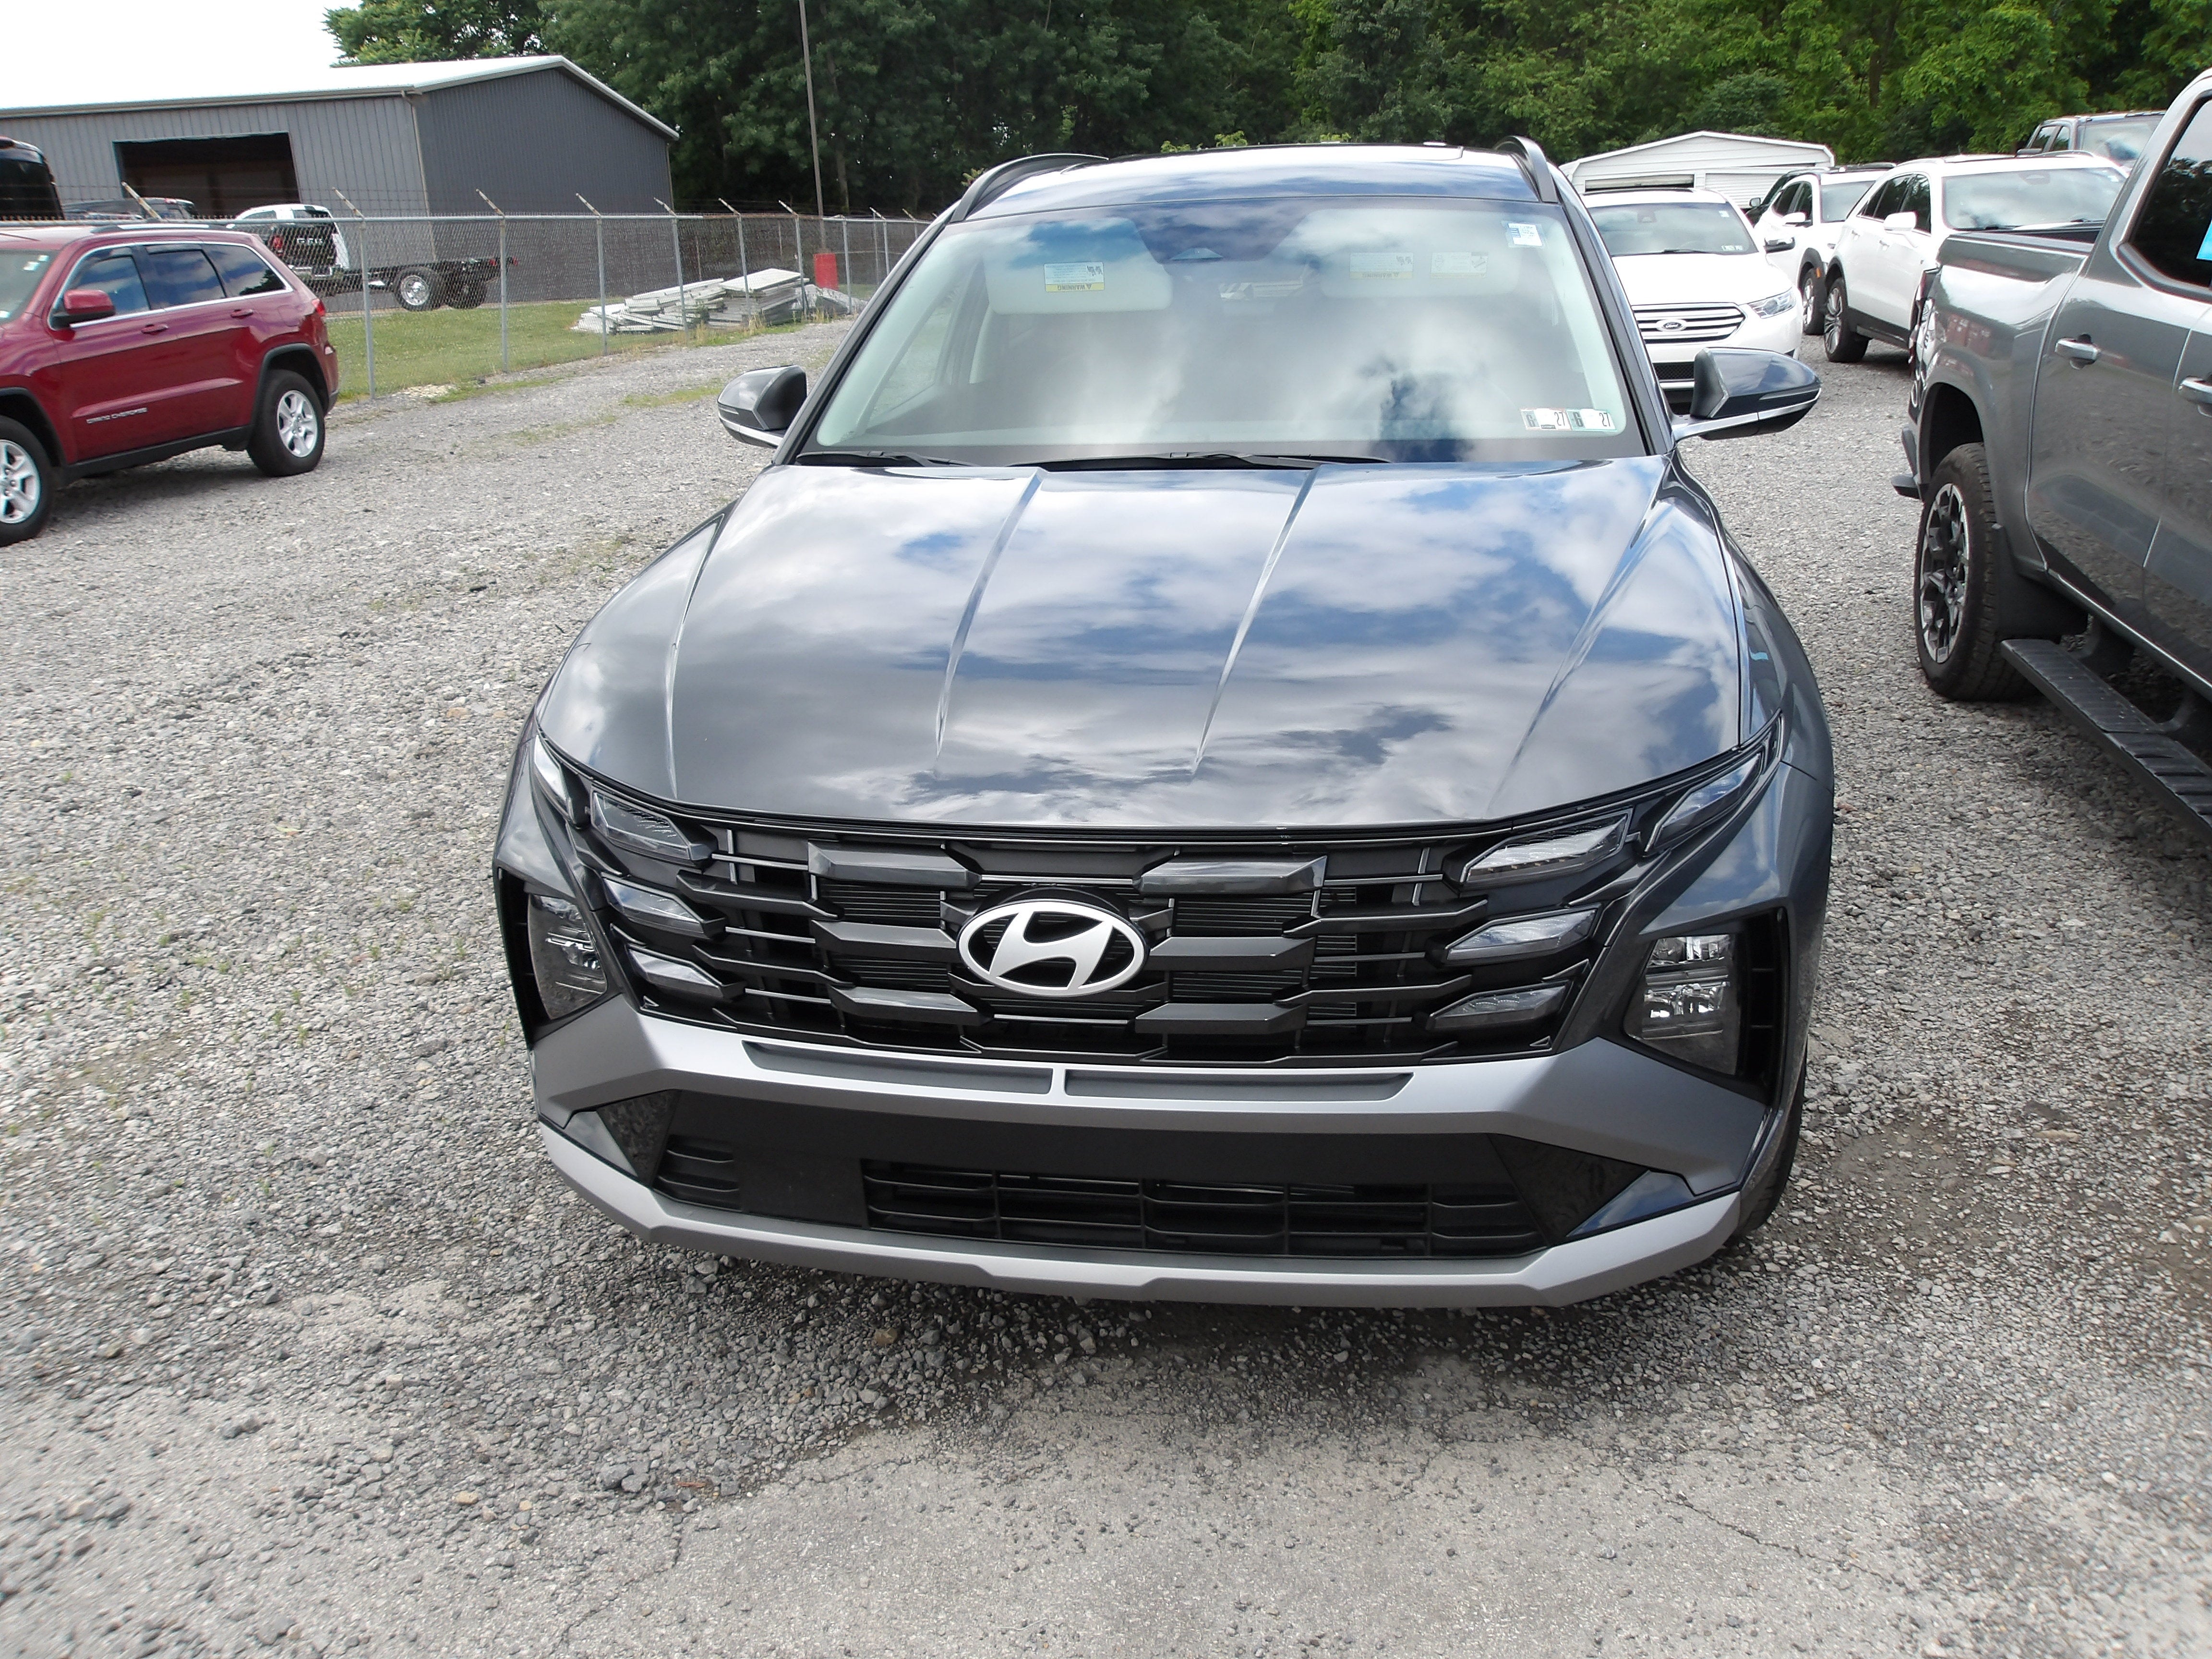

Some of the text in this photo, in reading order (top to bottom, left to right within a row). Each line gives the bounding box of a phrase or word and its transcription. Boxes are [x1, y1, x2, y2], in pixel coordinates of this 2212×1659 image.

[1526, 412, 1565, 428] 6 27
[1573, 411, 1611, 428] 6 27
